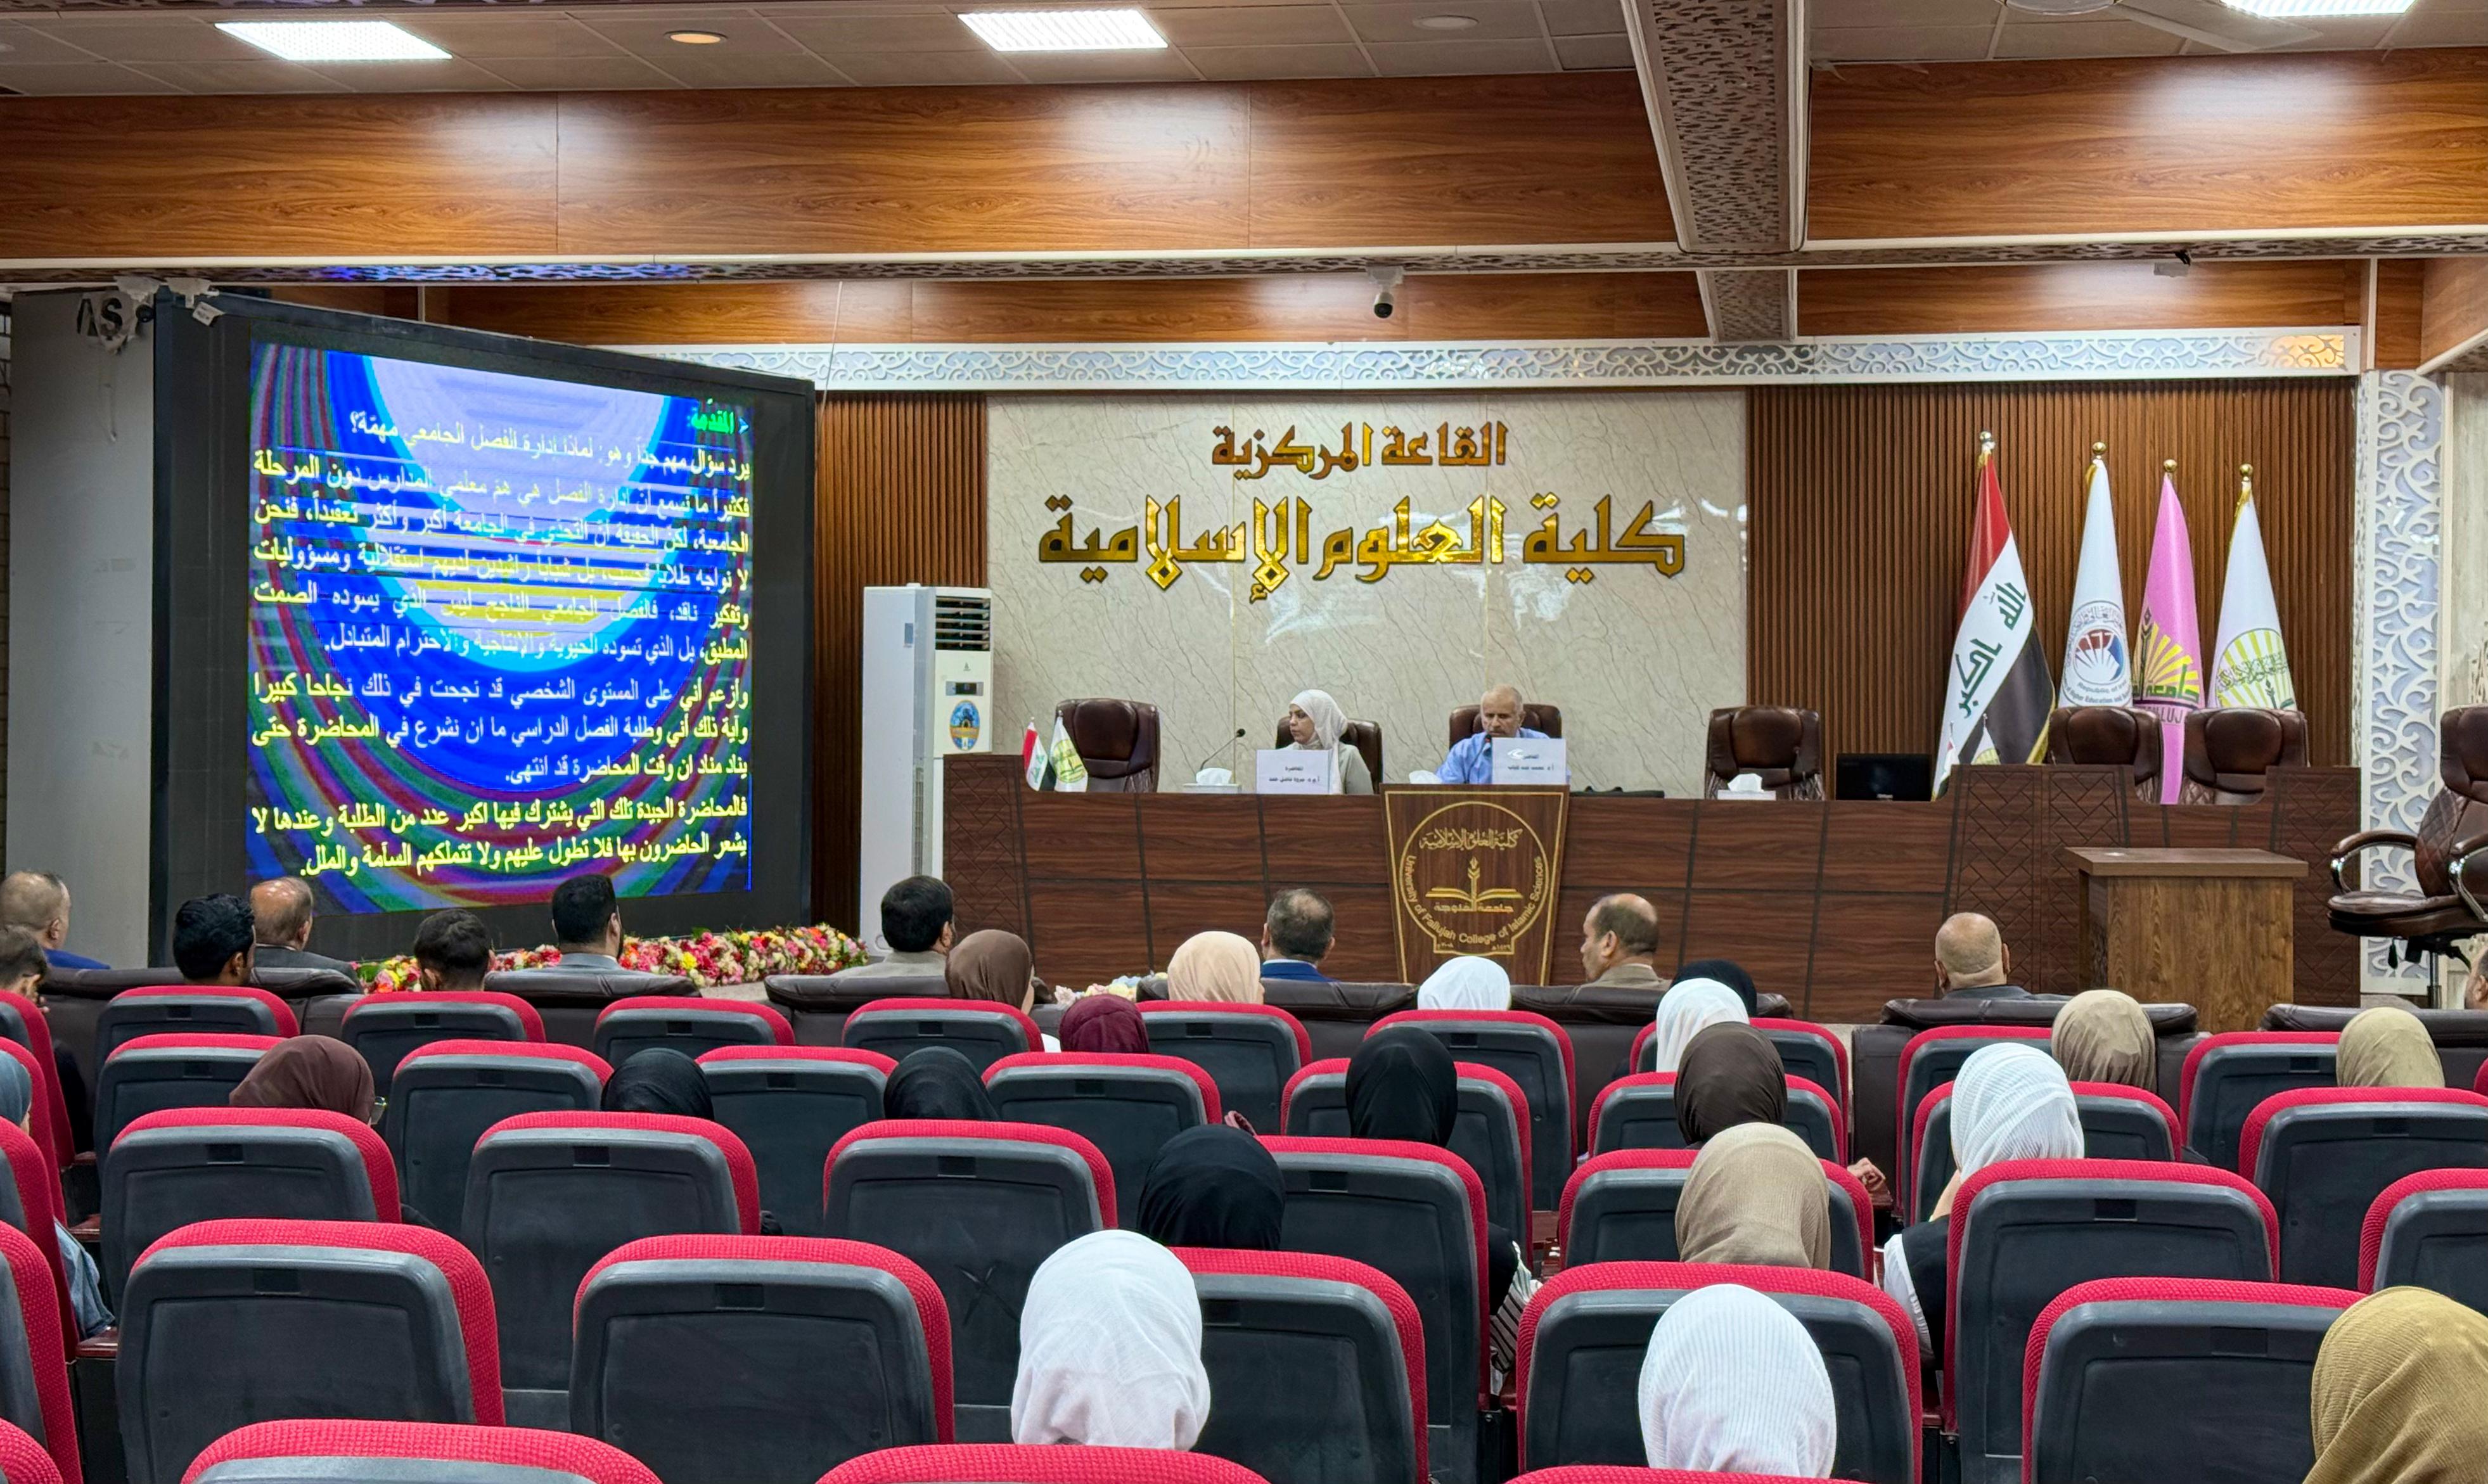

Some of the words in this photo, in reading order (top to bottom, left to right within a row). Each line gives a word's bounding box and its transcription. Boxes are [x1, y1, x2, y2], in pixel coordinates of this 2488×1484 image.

[405, 421, 465, 449] الجامعي
[471, 425, 517, 451] الفصل
[563, 434, 593, 457] لماذا
[1382, 420, 1510, 468] القاعة
[691, 449, 725, 478] سؤال
[1210, 420, 1375, 481] المركزية
[253, 448, 320, 485] المرحلة
[326, 463, 361, 490] دون
[367, 464, 432, 493] المدارس
[663, 456, 687, 476] مهم
[439, 469, 487, 502] معلمي
[548, 477, 591, 504] الفصل
[254, 495, 300, 524] فنحن
[656, 494, 691, 520] نسمع
[695, 489, 709, 514] ما
[454, 511, 508, 540] الجامعة
[1312, 492, 1508, 584] العلوم
[1522, 490, 1687, 587] كلية
[357, 541, 423, 572] استقلالية
[1037, 492, 1314, 604] الإسلامية
[577, 557, 596, 584] بل
[696, 566, 733, 594] نواجه
[736, 567, 749, 592] لا
[254, 578, 317, 604] الصمت
[331, 588, 381, 614] يسوده
[392, 585, 426, 620] الذي
[485, 590, 530, 623] الناجح
[542, 591, 598, 625] الجامعي
[610, 592, 658, 621] فالفصل
[709, 601, 749, 630] وتفكير
[1983, 582, 2027, 631] الله
[549, 631, 598, 660] الحيوية
[601, 636, 643, 662] تسوده
[644, 634, 674, 665] الذي
[677, 634, 696, 662] بل
[253, 671, 298, 704] كبيرا
[306, 672, 354, 702] نجاحا
[361, 672, 392, 696] ذلك
[399, 674, 422, 706] في
[430, 679, 480, 703] نجحت
[487, 675, 504, 699] قد
[510, 675, 576, 710] الشخصي
[583, 678, 640, 707] المستوى
[645, 678, 673, 708] على
[252, 713, 293, 747] حتى
[297, 711, 380, 746] المحاضرة
[385, 715, 409, 749] في
[414, 714, 461, 748] نشرع
[491, 714, 507, 738] ما
[511, 713, 569, 748] الدراسي
[575, 713, 619, 741] الفصل
[622, 715, 664, 745] وطلبة
[693, 715, 719, 738] ذلك
[554, 753, 569, 776] قد
[572, 752, 640, 783] المحاضرة
[643, 753, 674, 781] وقت
[697, 753, 723, 774] مناد
[252, 806, 269, 834] لا
[338, 802, 386, 834] الطلبة
[391, 807, 416, 834] من
[420, 806, 450, 826] عدد
[456, 801, 489, 832] اكبر
[493, 800, 520, 830] فيها
[525, 798, 574, 829] يشترك
[577, 796, 605, 831] التي
[609, 796, 634, 820] تلك
[637, 795, 674, 825] الجيدة
[677, 794, 748, 824] فالمحاضرة
[416, 840, 473, 876] تتملكهم
[476, 841, 501, 870] ولا
[504, 836, 544, 873] عليهم
[549, 836, 589, 867] تطول
[593, 835, 614, 858] فلا
[616, 838, 637, 863] بها
[639, 830, 710, 863] الحاضرون
[714, 831, 748, 859] يشعر
[1404, 855, 1418, 903] University
[1414, 904, 1427, 915] of
[1422, 912, 1456, 940] Fallujah
[1459, 933, 1497, 945] College
[1497, 926, 1509, 938] of
[1508, 902, 1536, 932] Islamic
[1530, 855, 1544, 902] Sciences
